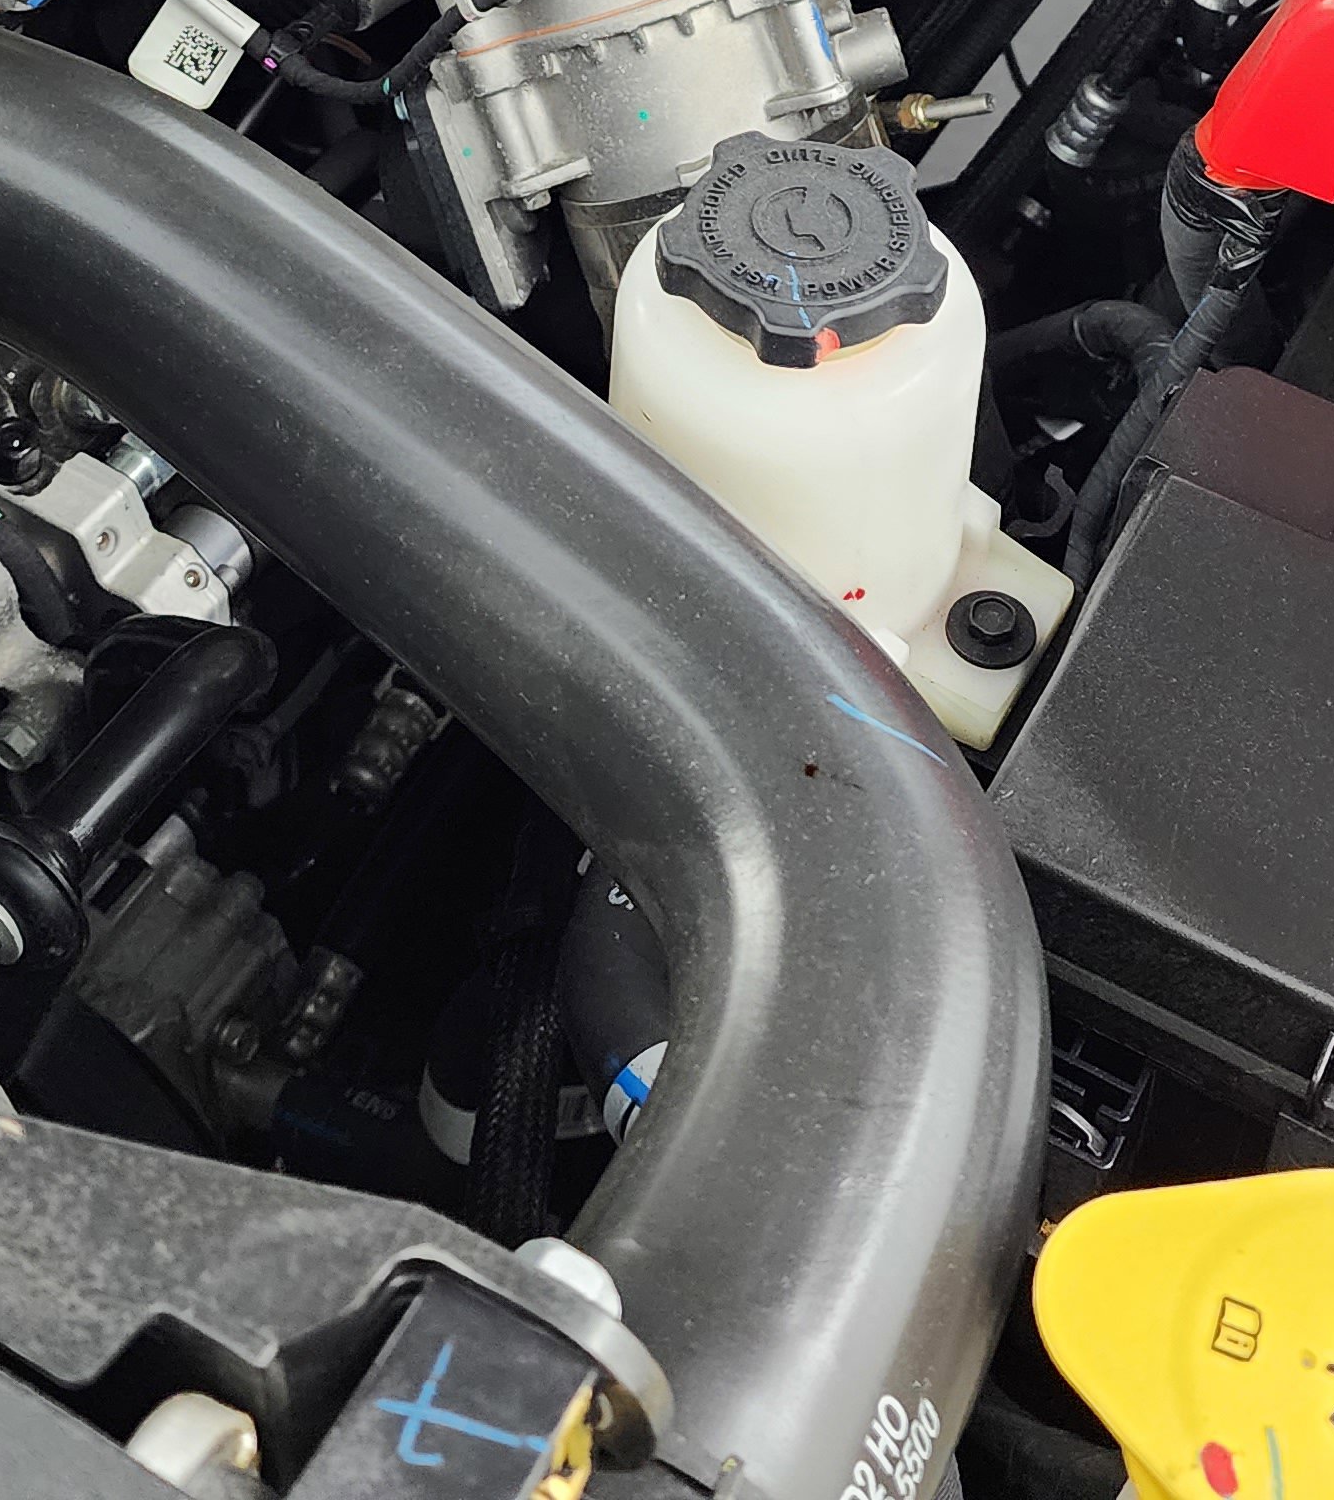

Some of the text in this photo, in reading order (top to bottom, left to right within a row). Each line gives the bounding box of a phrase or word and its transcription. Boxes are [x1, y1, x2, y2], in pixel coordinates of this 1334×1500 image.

[698, 162, 783, 293] USE APPROVED
[848, 160, 913, 253] STEERING
[804, 255, 898, 297] POWER
[864, 1394, 909, 1476] HO
